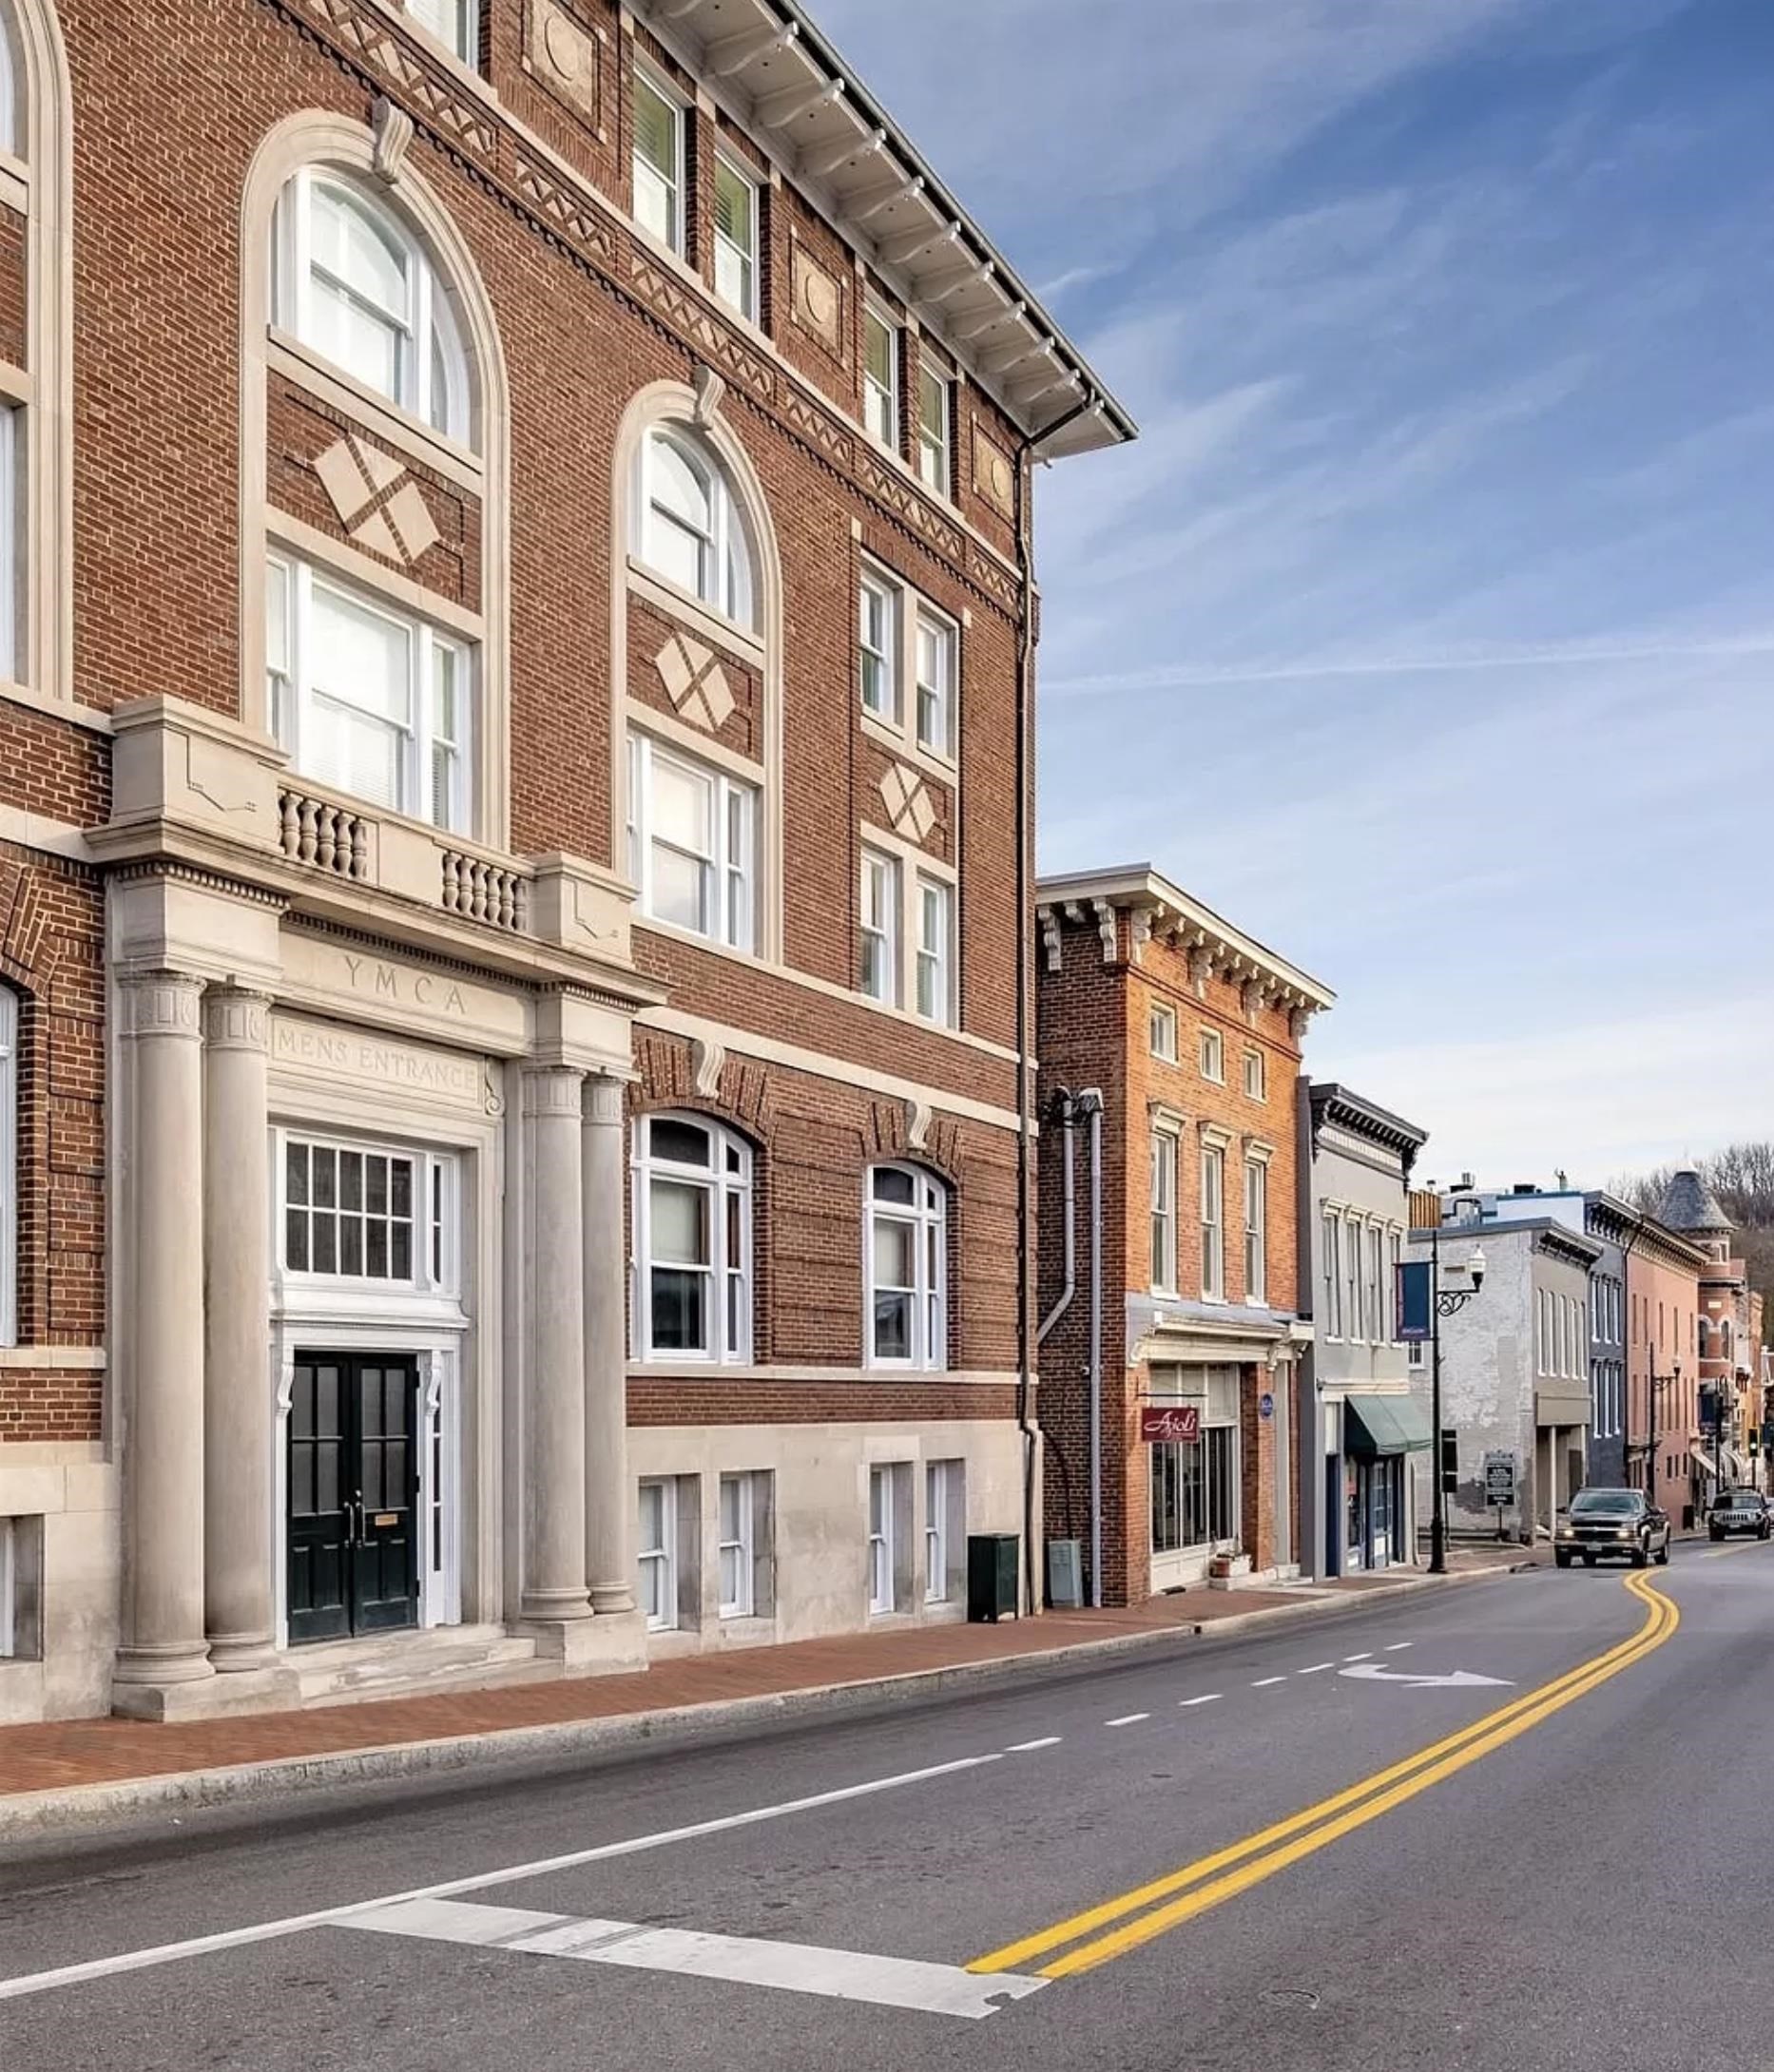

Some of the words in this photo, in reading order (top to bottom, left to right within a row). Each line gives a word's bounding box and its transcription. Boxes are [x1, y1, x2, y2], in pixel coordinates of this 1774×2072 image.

[345, 955, 465, 1014] YMCA
[279, 1028, 347, 1063] MENS
[359, 1046, 475, 1089] ENTRANCE
